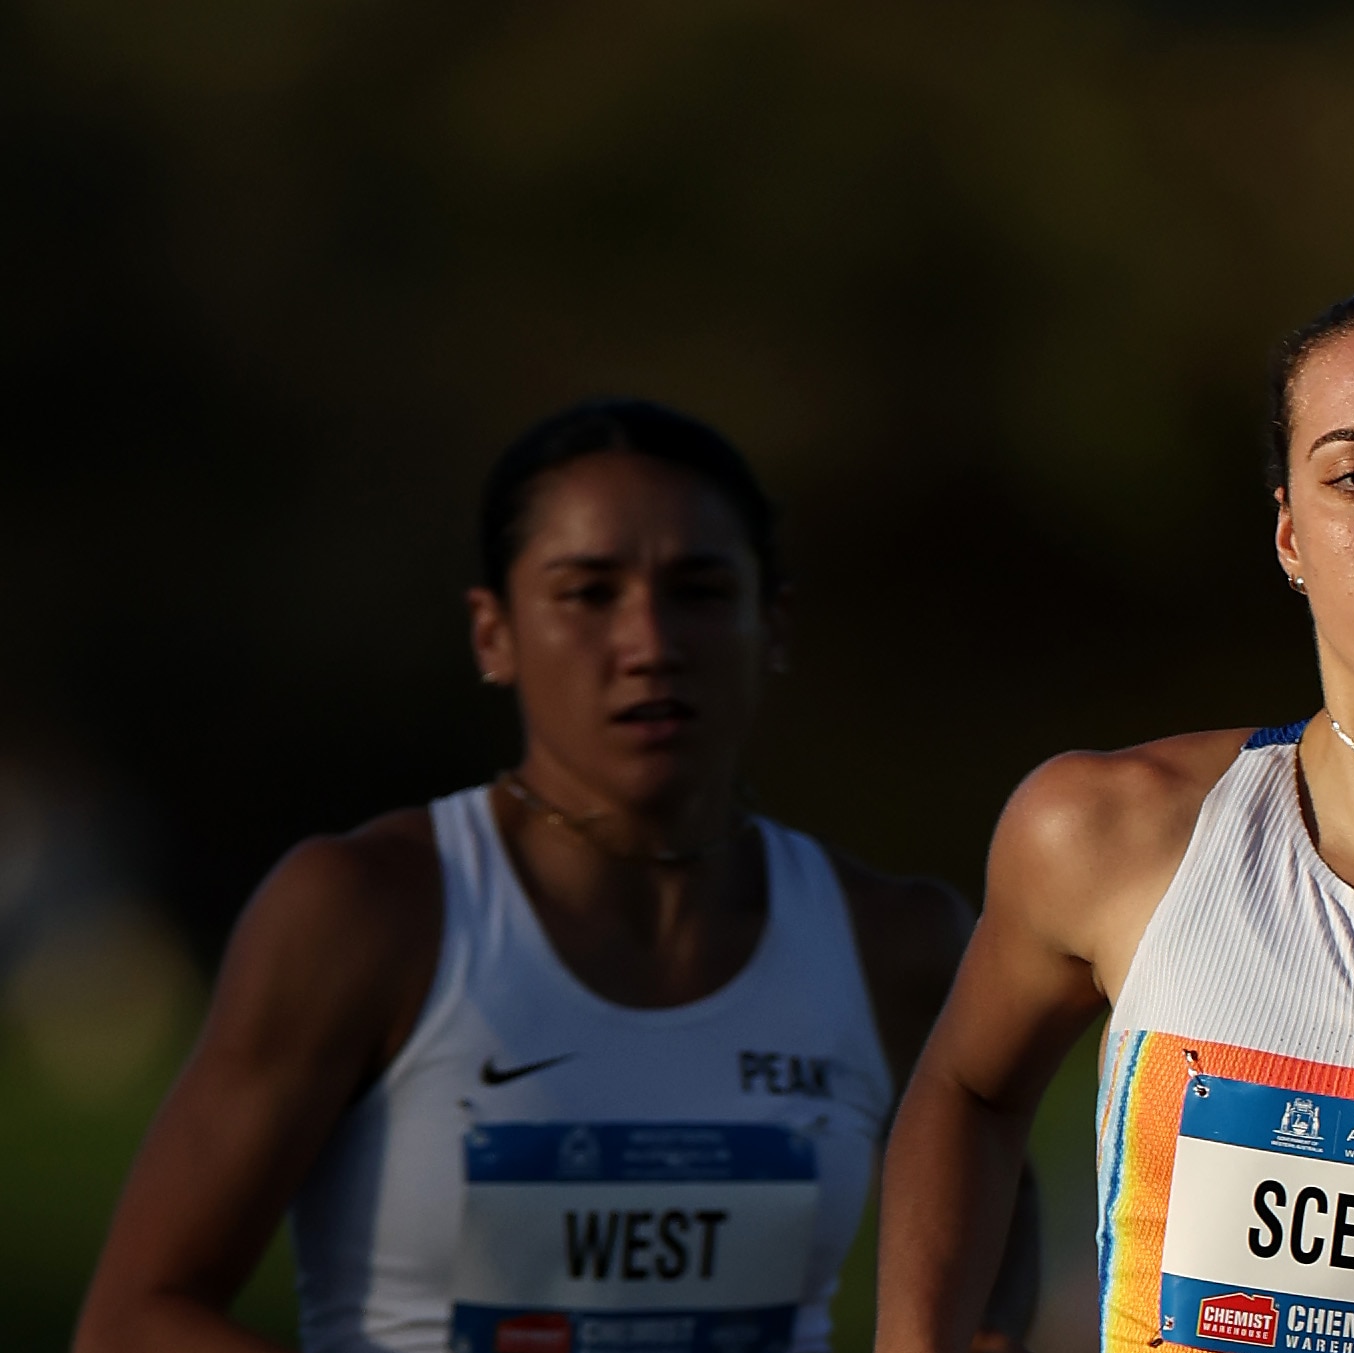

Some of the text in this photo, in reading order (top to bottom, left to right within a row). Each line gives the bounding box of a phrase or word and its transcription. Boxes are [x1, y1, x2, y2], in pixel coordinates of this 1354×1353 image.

[739, 1050, 834, 1098] PEAK
[564, 1210, 729, 1281] WEST
[1202, 1322, 1269, 1340] WAREHOUSE
[1203, 1305, 1274, 1330] CHEMIST
